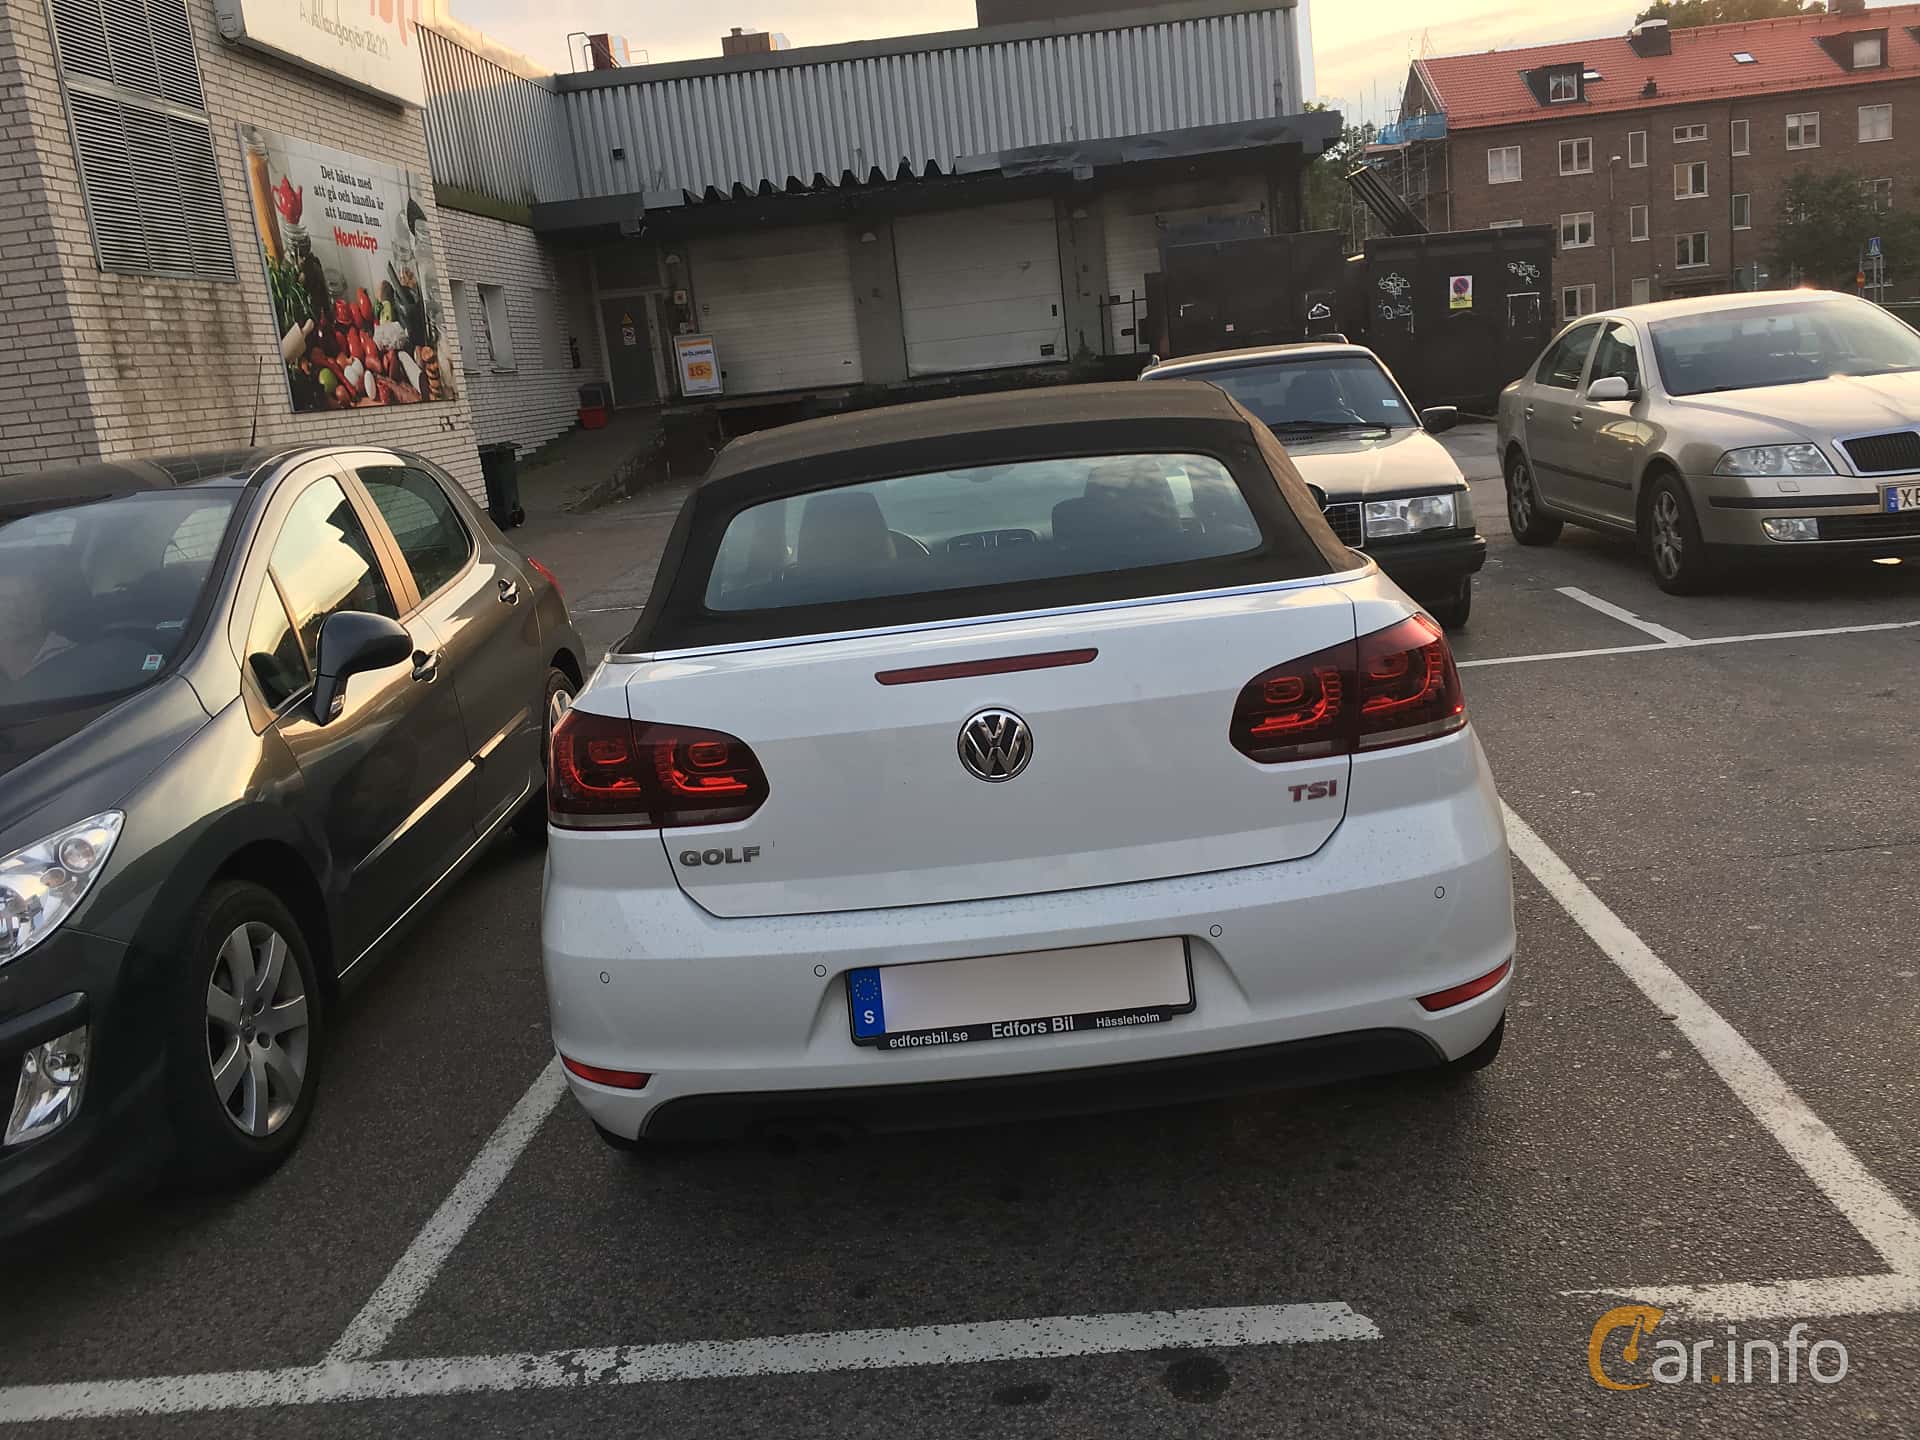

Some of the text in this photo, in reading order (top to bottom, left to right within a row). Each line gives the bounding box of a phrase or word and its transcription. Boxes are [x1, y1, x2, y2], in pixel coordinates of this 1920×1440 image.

[320, 165, 335, 181] Det
[357, 177, 372, 190] med
[313, 184, 384, 210] att gå och handla är
[324, 206, 382, 227] att komma hem.
[334, 225, 378, 254] Hemköp
[1287, 779, 1337, 802] TSI
[679, 846, 761, 867] GOLF
[863, 1009, 875, 1024] S
[888, 1012, 1160, 1049] edforsbil.se Edfors Bil Hässleholm
